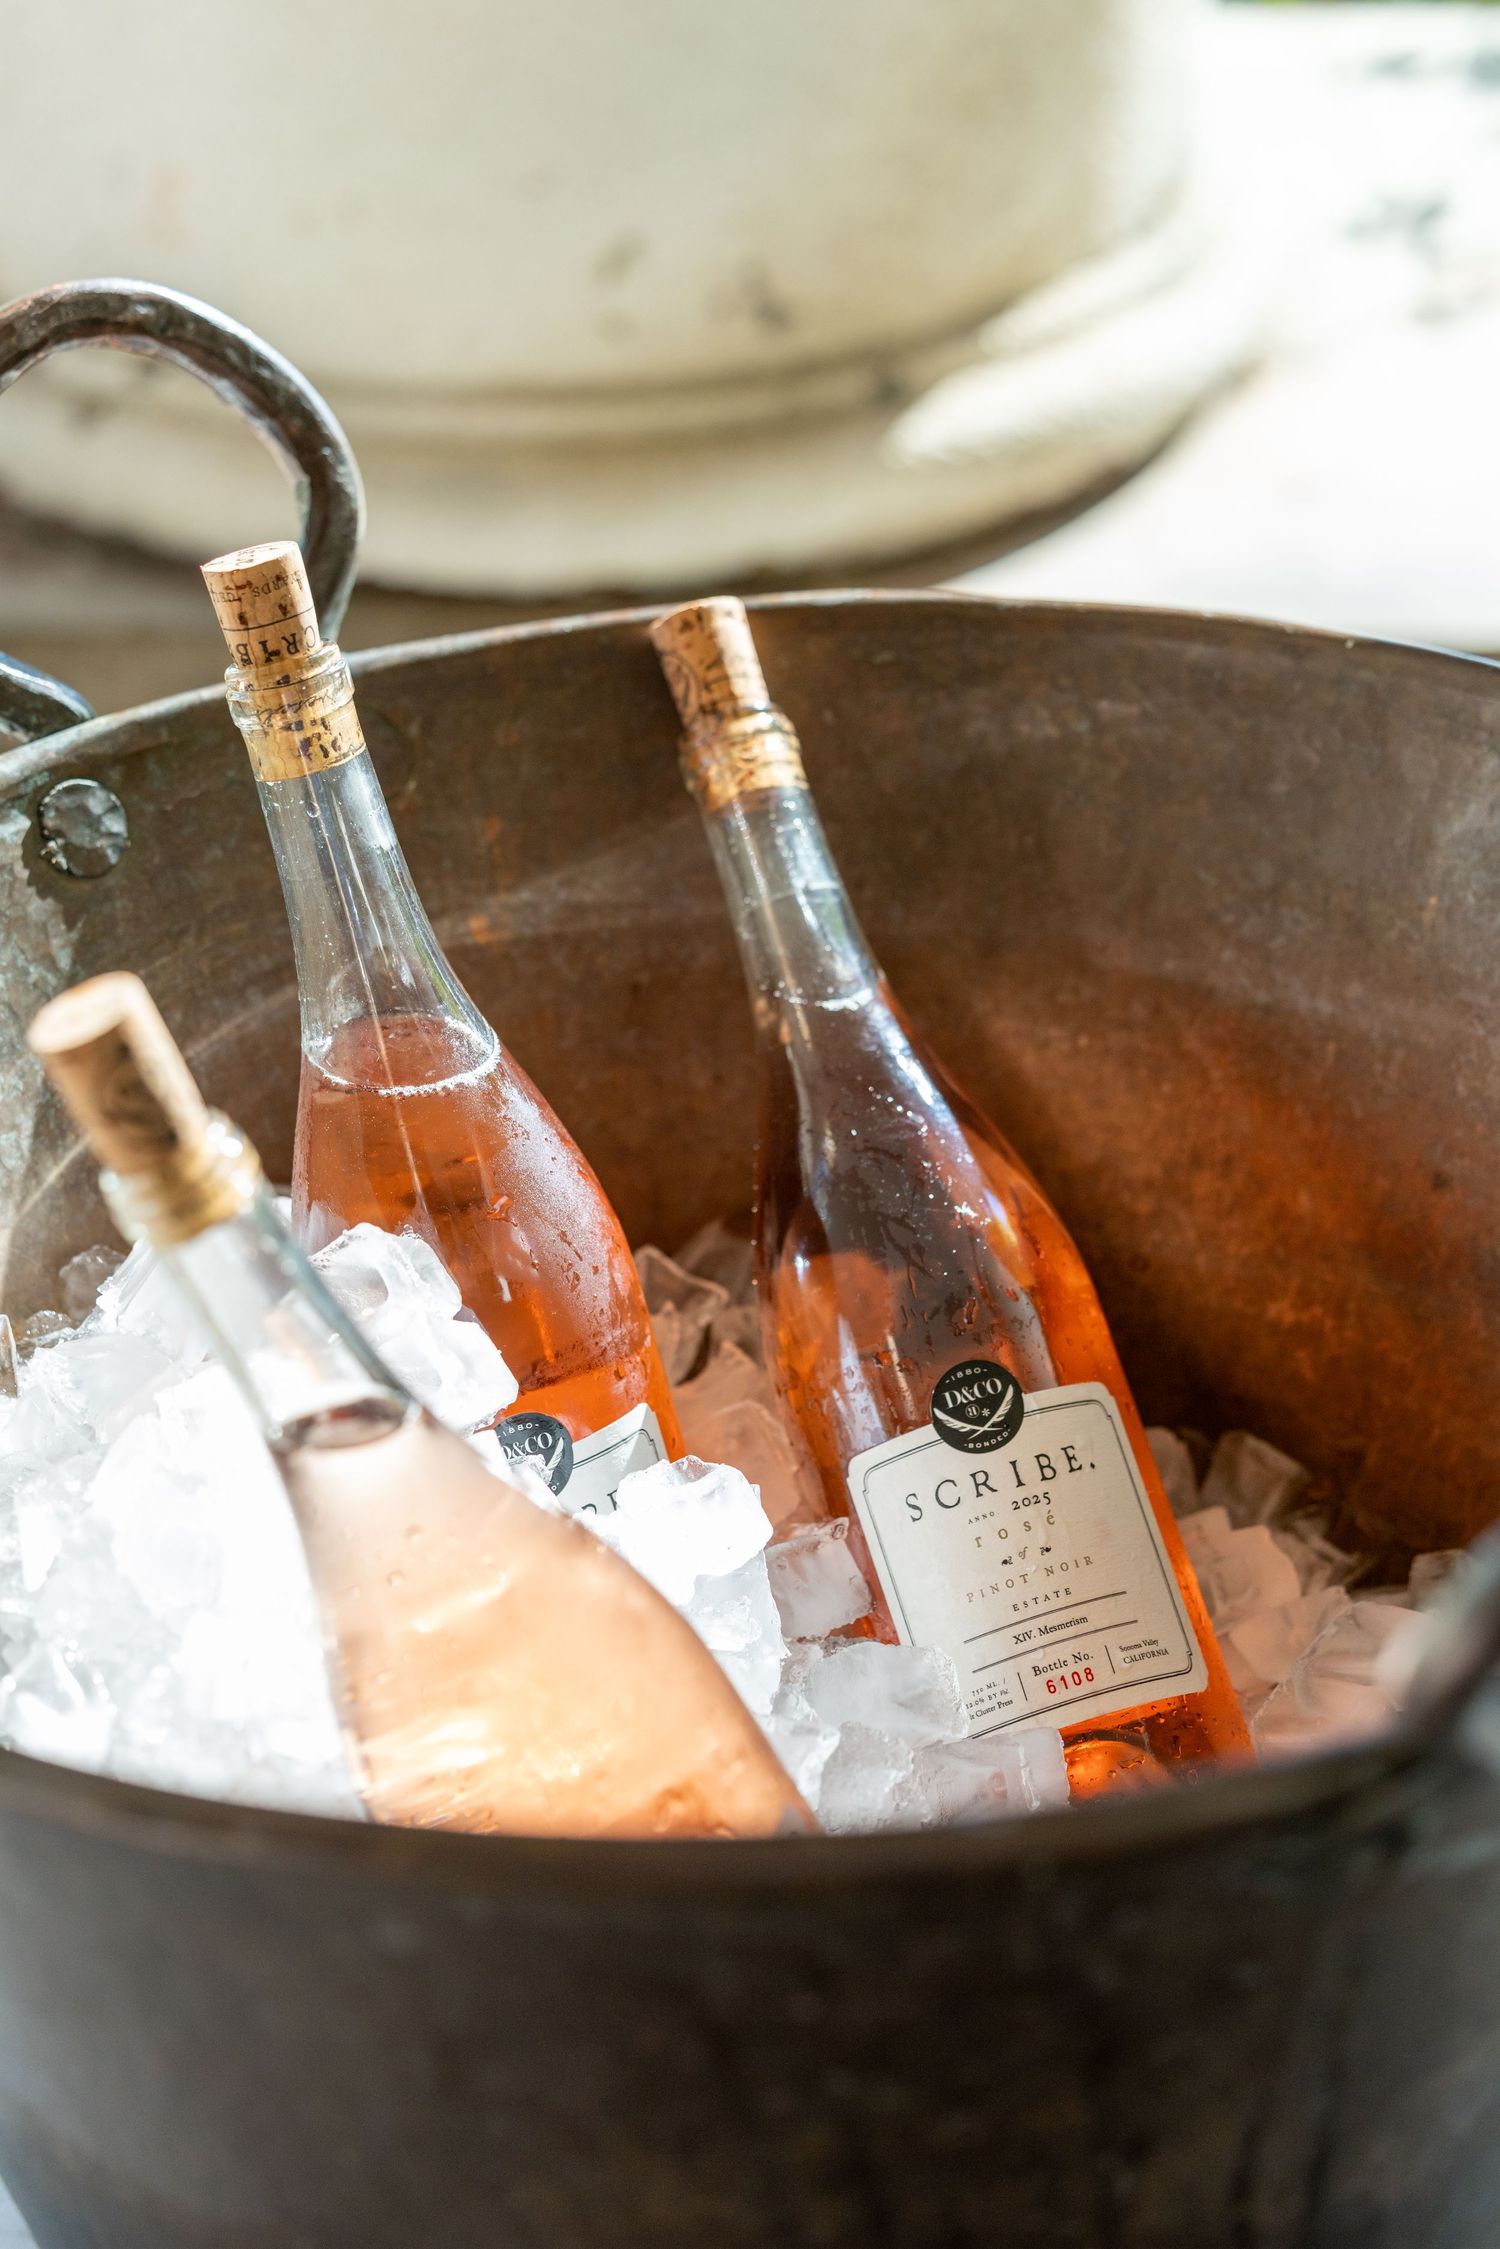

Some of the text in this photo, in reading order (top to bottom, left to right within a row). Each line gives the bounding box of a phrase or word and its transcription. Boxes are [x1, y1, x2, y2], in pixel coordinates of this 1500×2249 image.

[229, 625, 316, 667] CRIB
[942, 1377, 1003, 1410] D&CO
[905, 1444, 1096, 1523] SCRIBE.
[1011, 1491, 1052, 1511] 2025
[974, 1509, 1056, 1549] rosé
[1018, 1546, 1028, 1561] of
[966, 1555, 1094, 1603] PINOT NOIR
[1012, 1587, 1072, 1612] ESTATE
[1012, 1615, 1089, 1645] XIV. Mesmerism
[1118, 1643, 1143, 1653] Sonoma
[1122, 1647, 1170, 1665] CALIFORNIA
[1031, 1651, 1094, 1677] Bottle No.
[1045, 1666, 1095, 1695] 6108
[997, 1698, 1014, 1710] Press
